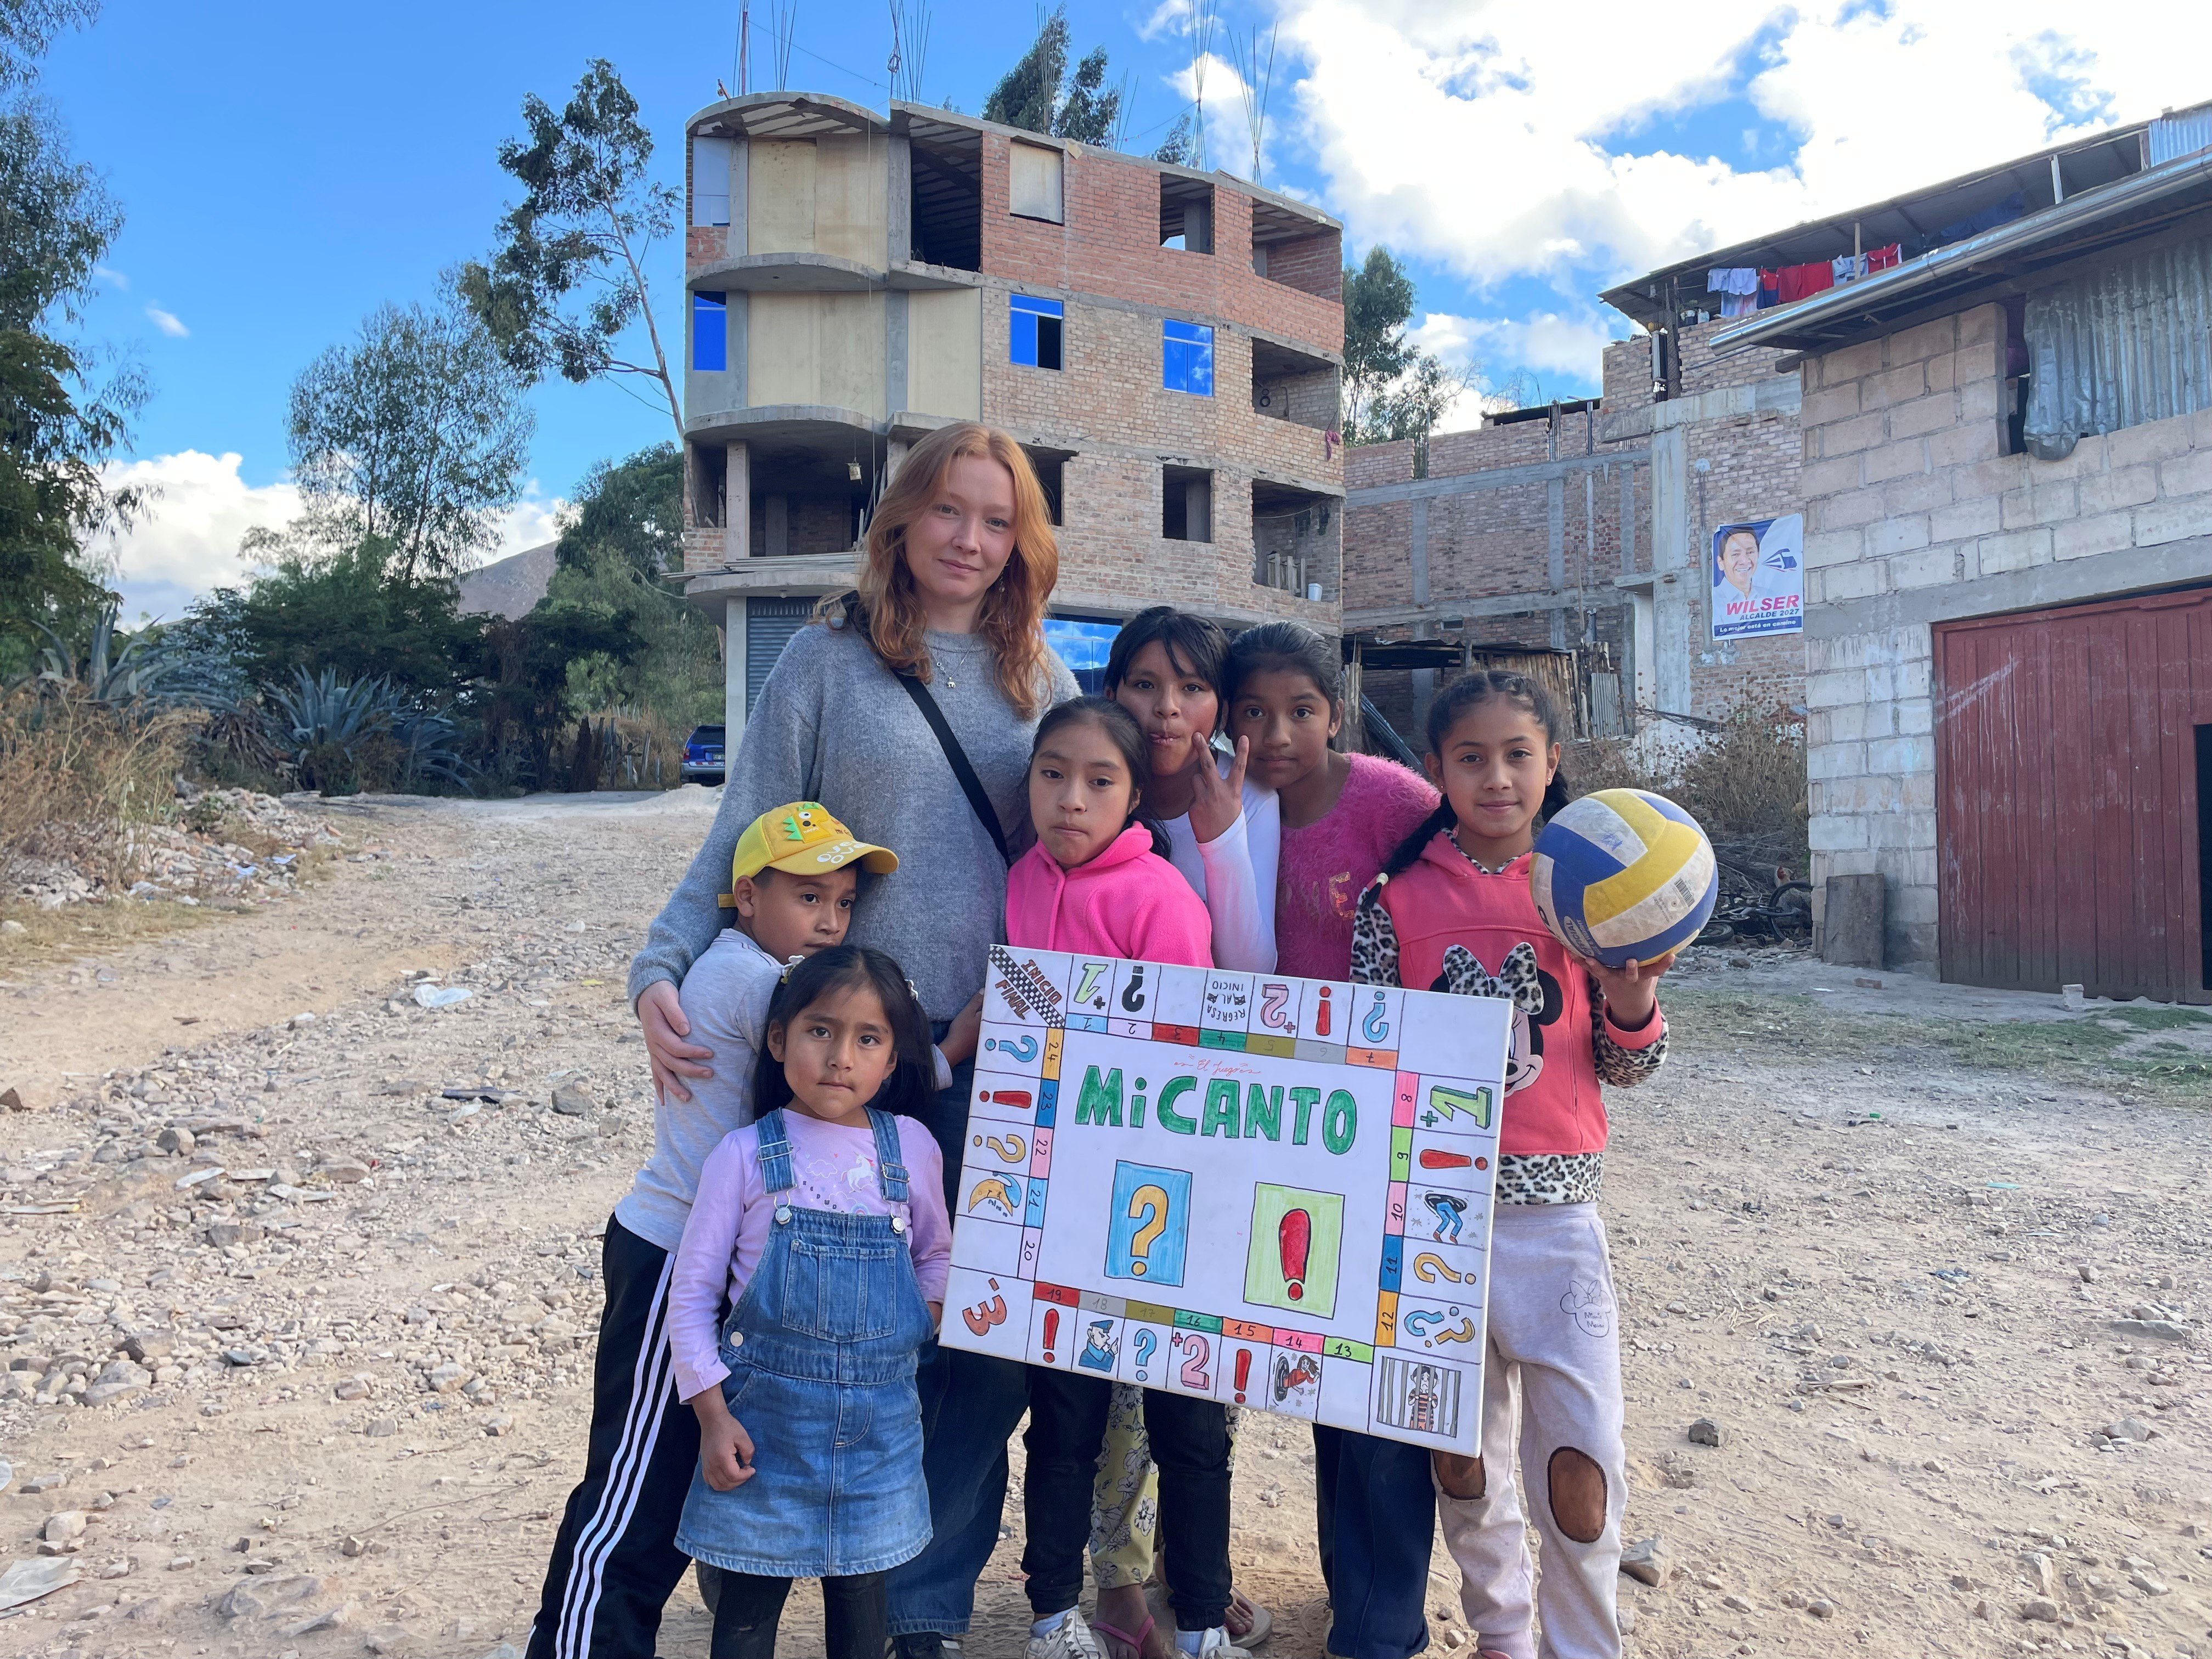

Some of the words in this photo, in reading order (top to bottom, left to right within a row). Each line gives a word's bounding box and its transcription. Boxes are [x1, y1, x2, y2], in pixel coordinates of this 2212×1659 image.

[1726, 595, 1799, 616] WILSER
[1740, 611, 1778, 621] ALCALDE
[1020, 958, 1063, 1005] INICIO
[1212, 981, 1244, 992] INICIO
[995, 979, 1031, 1020] FINAL
[1222, 994, 1232, 1005] AL
[1207, 1005, 1245, 1022] REGRESA
[1083, 1017, 1092, 1030] 1
[1128, 1023, 1136, 1035] 2
[1174, 1027, 1183, 1041] 3
[1217, 1031, 1226, 1045] 4
[1047, 1042, 1059, 1063] 24
[1263, 1040, 1276, 1052] 5
[1365, 1053, 1375, 1064] 7
[1041, 1091, 1053, 1110] 23
[1401, 1093, 1412, 1103] 8
[1035, 1138, 1048, 1156] 22
[1397, 1152, 1408, 1161] 9
[1028, 1188, 1041, 1208] 21
[1391, 1203, 1403, 1222] 10
[1024, 1240, 1035, 1261] 20
[1385, 1256, 1398, 1275] 11
[1047, 1288, 1062, 1301] 19
[1093, 1297, 1108, 1311] 18
[1140, 1307, 1156, 1318] 17
[1187, 1314, 1201, 1327] 16
[1380, 1311, 1394, 1331] 12
[1234, 1323, 1257, 1337] 15
[1285, 1335, 1303, 1349] 14
[1334, 1342, 1352, 1358] 13
